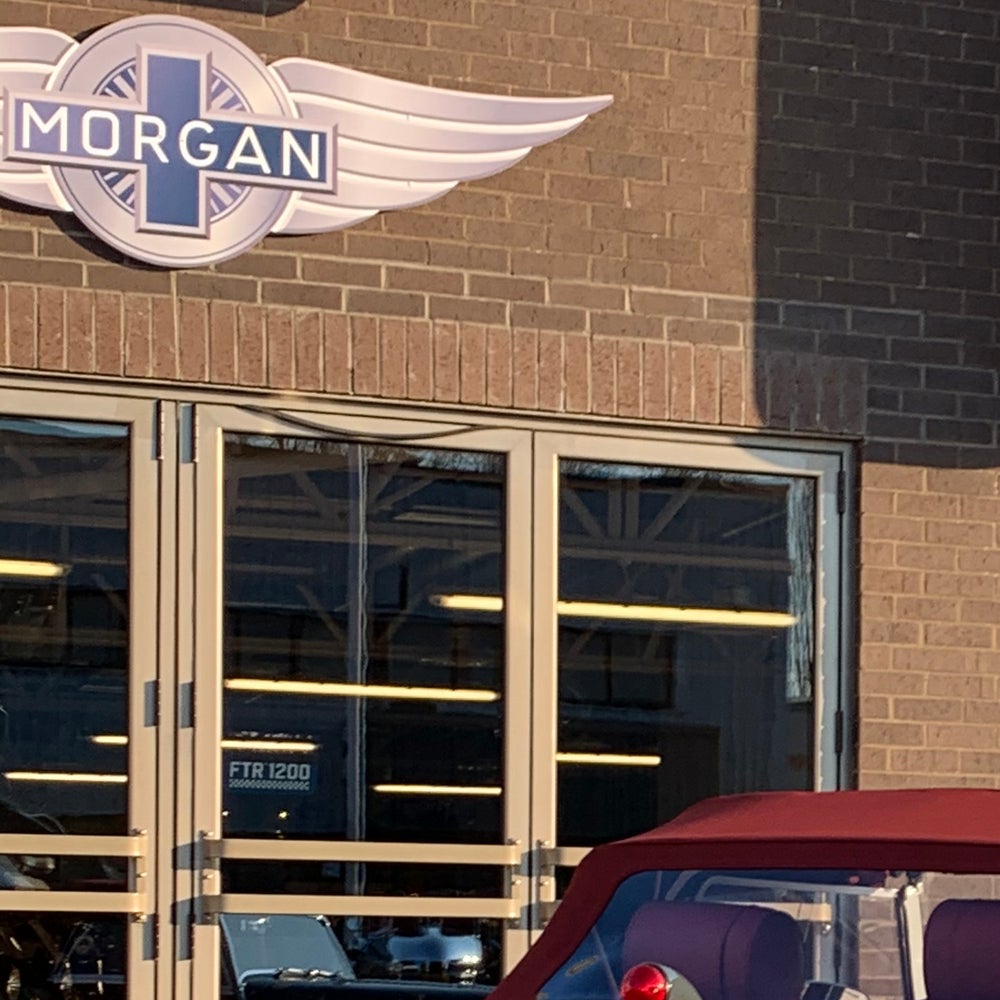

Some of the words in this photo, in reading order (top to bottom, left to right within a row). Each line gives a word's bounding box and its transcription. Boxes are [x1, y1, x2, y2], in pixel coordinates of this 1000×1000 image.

[22, 102, 320, 179] MORGAN
[229, 761, 264, 779] FTR
[269, 762, 311, 780] 1200
